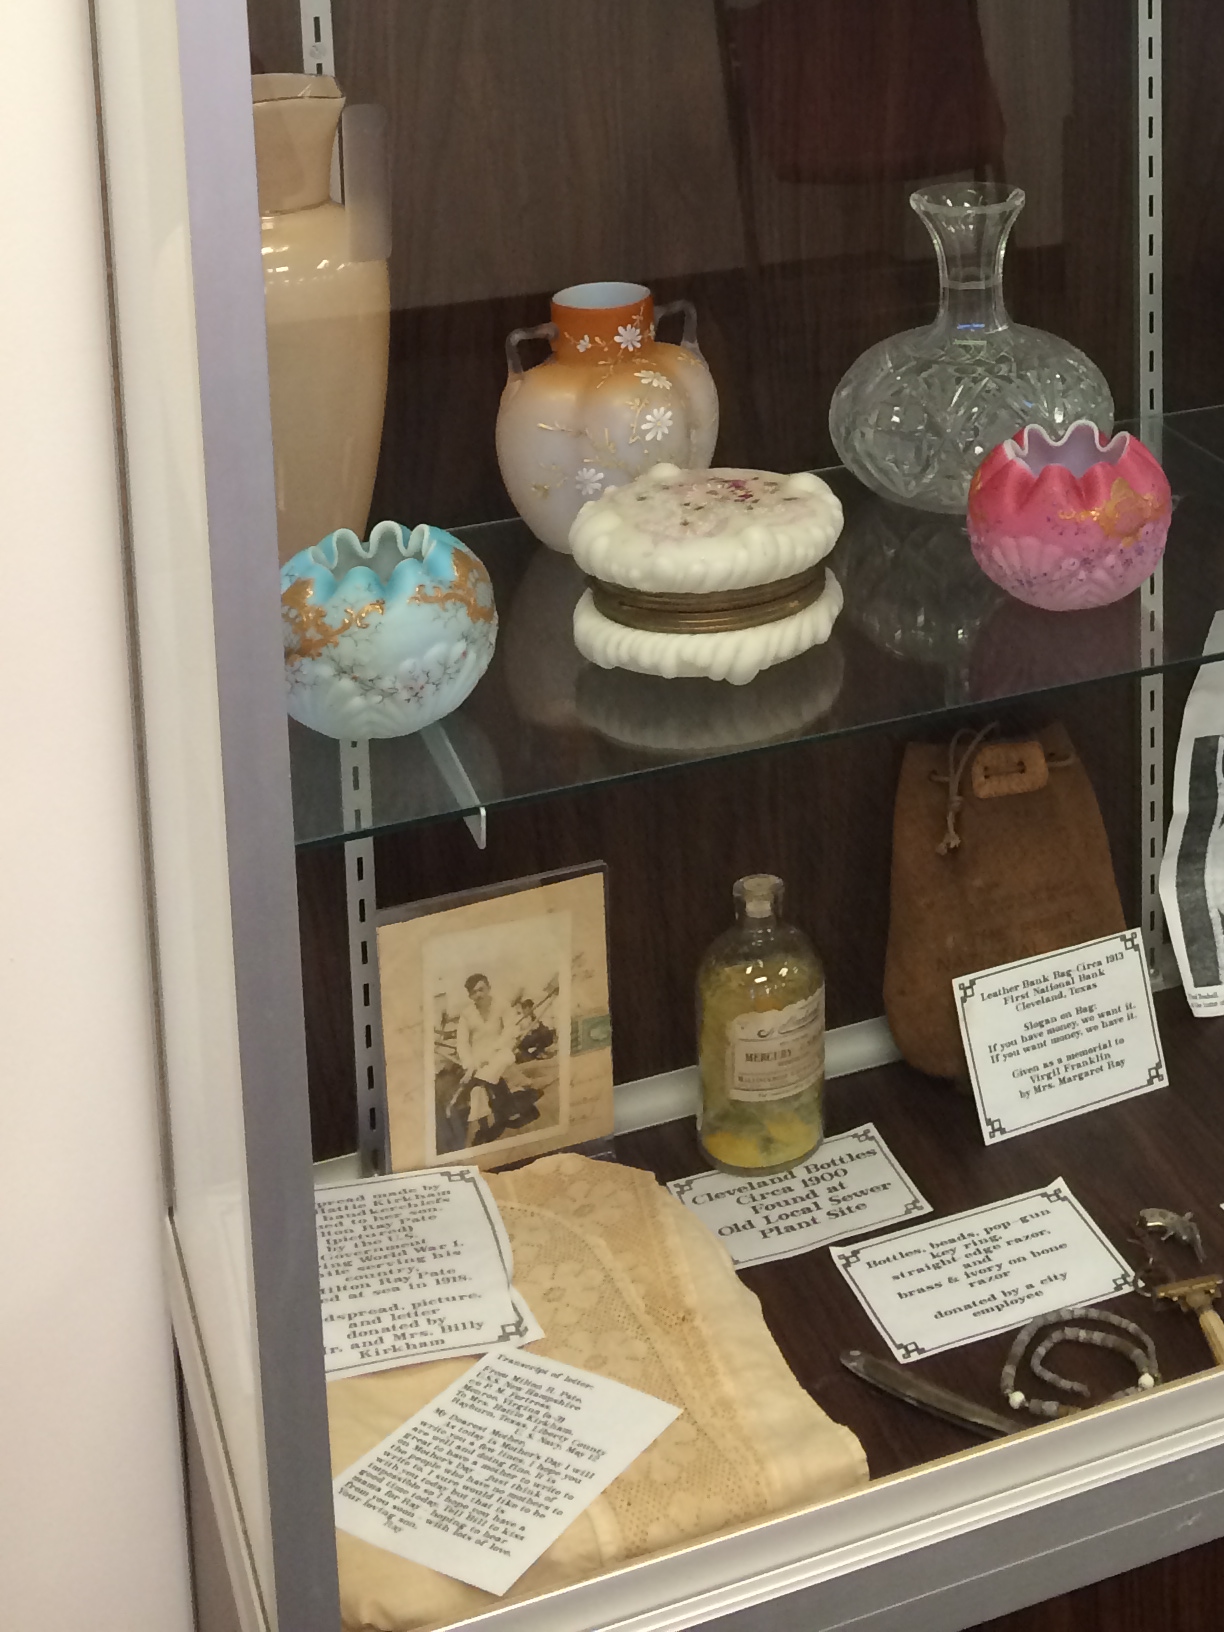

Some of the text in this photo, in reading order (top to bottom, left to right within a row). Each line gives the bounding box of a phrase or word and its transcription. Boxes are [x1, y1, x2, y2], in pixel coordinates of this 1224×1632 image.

[980, 984, 1020, 1002] Leather
[1021, 974, 1050, 989] Bank
[1105, 951, 1124, 964] 1913
[1003, 968, 1106, 1006] First National Bank
[1015, 982, 1098, 1012] Cleveland, Texas
[987, 1001, 1137, 1054] If you have money, we want it.
[1023, 1003, 1098, 1031] Slogan on Bag:
[990, 1012, 1137, 1064] If you want money, we have it.
[1011, 1037, 1125, 1079] Given as a memorial to
[1029, 1052, 1112, 1084] Virgil Franklin
[1018, 1058, 1125, 1100] by Mrs. Margaret Ray
[691, 1148, 878, 1205] Cleveland Bottles
[735, 1168, 849, 1205] Circa 1900
[717, 1182, 892, 1237] Old Local Sewer
[750, 1180, 847, 1215] Found at
[758, 1203, 867, 1240] Plant Site
[865, 1248, 927, 1269] Bottles,
[928, 1232, 980, 1250] beads,
[929, 1234, 1003, 1260] key ring,
[962, 1254, 993, 1270] and
[896, 1243, 1068, 1300] brass & ivory on bone
[968, 1270, 1011, 1288] razor
[933, 1293, 998, 1320] donated
[1000, 1287, 1019, 1298] by
[1039, 1272, 1067, 1285] city
[972, 1290, 1044, 1318] employee
[346, 1316, 446, 1340] donated by
[348, 1307, 441, 1329] and letter
[350, 1320, 484, 1350] and Mrs. Billy
[358, 1338, 446, 1360] Kirkham
[497, 1353, 549, 1375] Transcript
[435, 1407, 447, 1418] My
